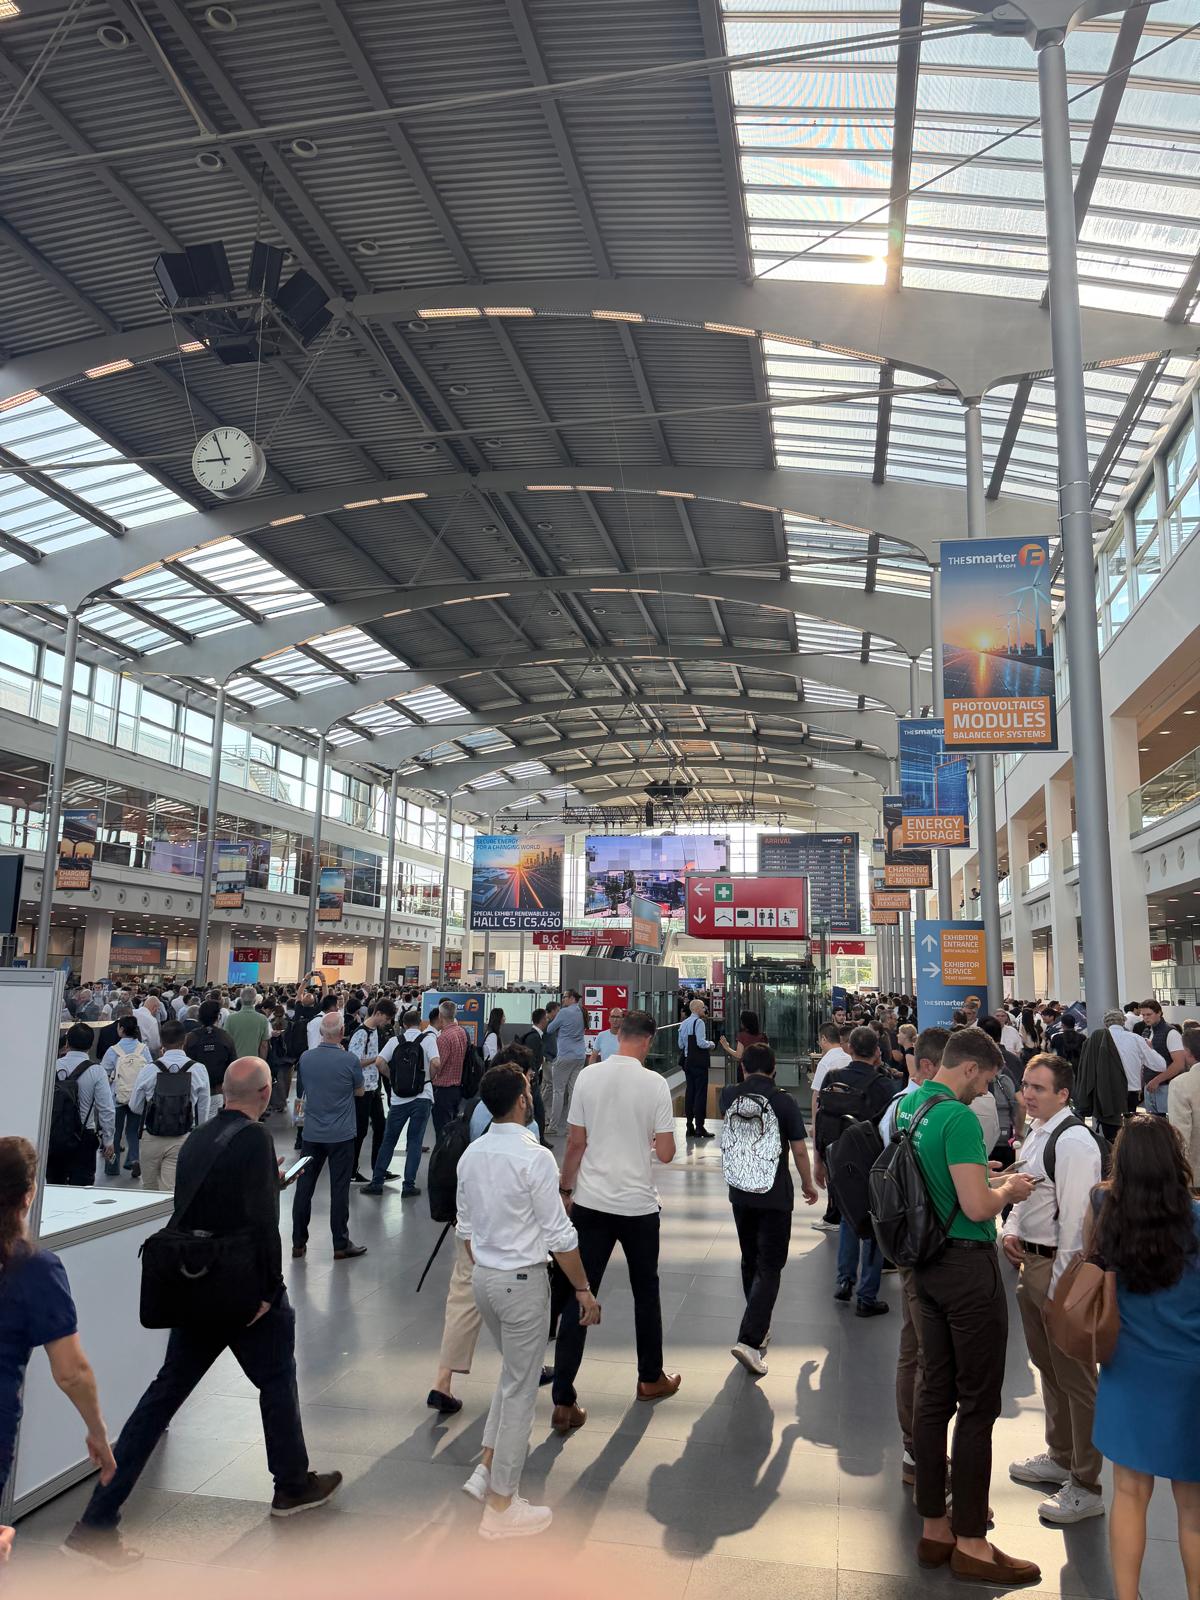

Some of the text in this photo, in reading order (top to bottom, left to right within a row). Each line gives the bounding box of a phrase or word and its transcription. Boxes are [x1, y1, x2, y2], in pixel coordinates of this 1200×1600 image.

[952, 700, 1045, 711] PHOTOVOLTAICS
[953, 712, 1046, 729] MODULES
[953, 731, 992, 739] BALANCE
[1006, 730, 1046, 738] SYSTEMS
[907, 818, 961, 830] ENERGY
[907, 830, 960, 840] STORAGE
[473, 917, 500, 927] HALL
[502, 917, 516, 927] C5
[523, 917, 561, 928] C5.450
[837, 946, 845, 954] A
